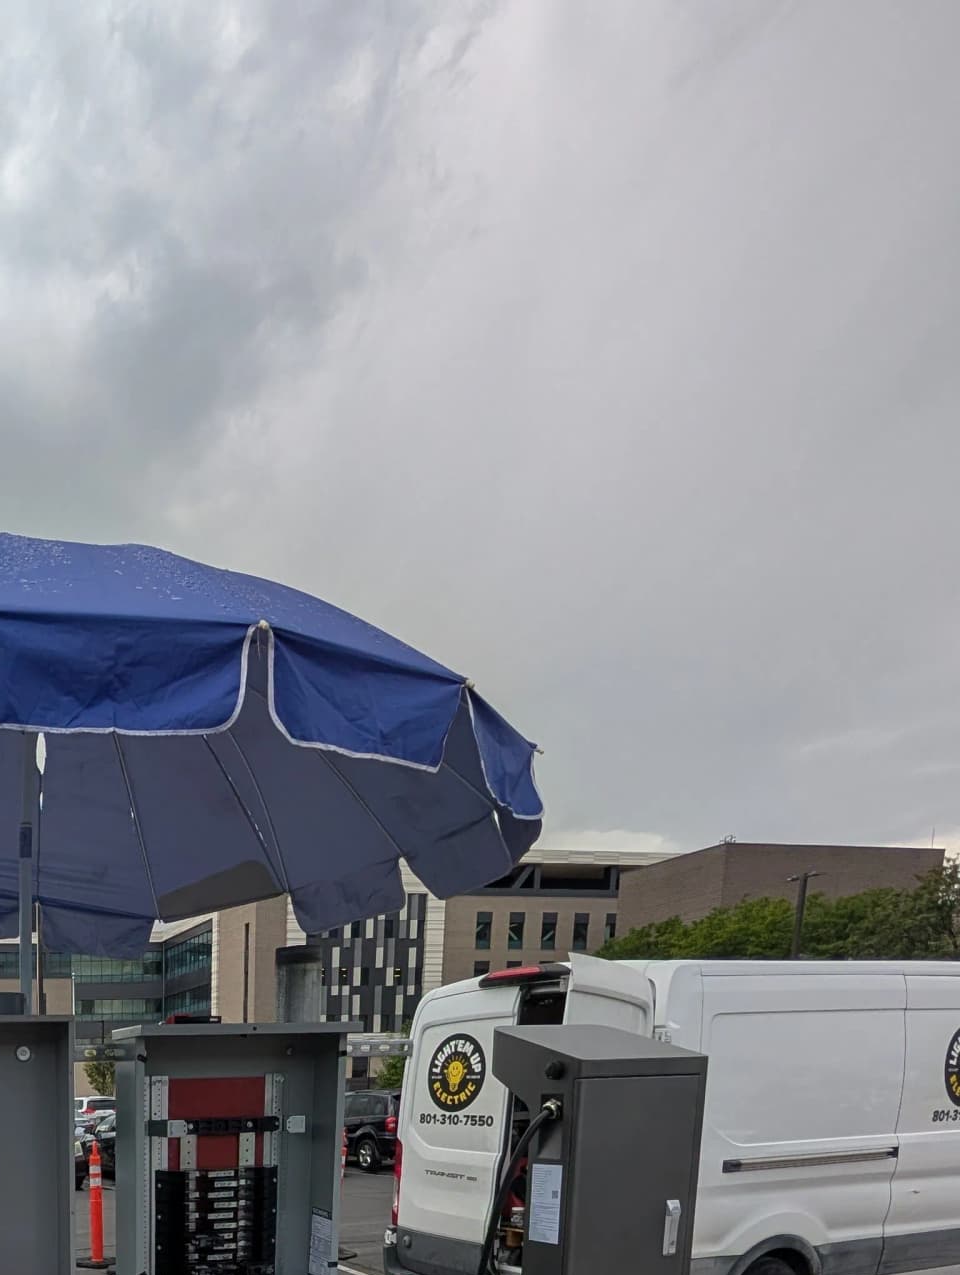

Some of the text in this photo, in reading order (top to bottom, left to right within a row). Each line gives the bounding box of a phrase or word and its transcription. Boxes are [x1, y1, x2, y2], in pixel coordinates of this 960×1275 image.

[469, 1051, 482, 1073] UP
[432, 1081, 477, 1105] ELECTRIC
[419, 1113, 494, 1127] 801-310-7550
[424, 1169, 465, 1180] TRANSIT
